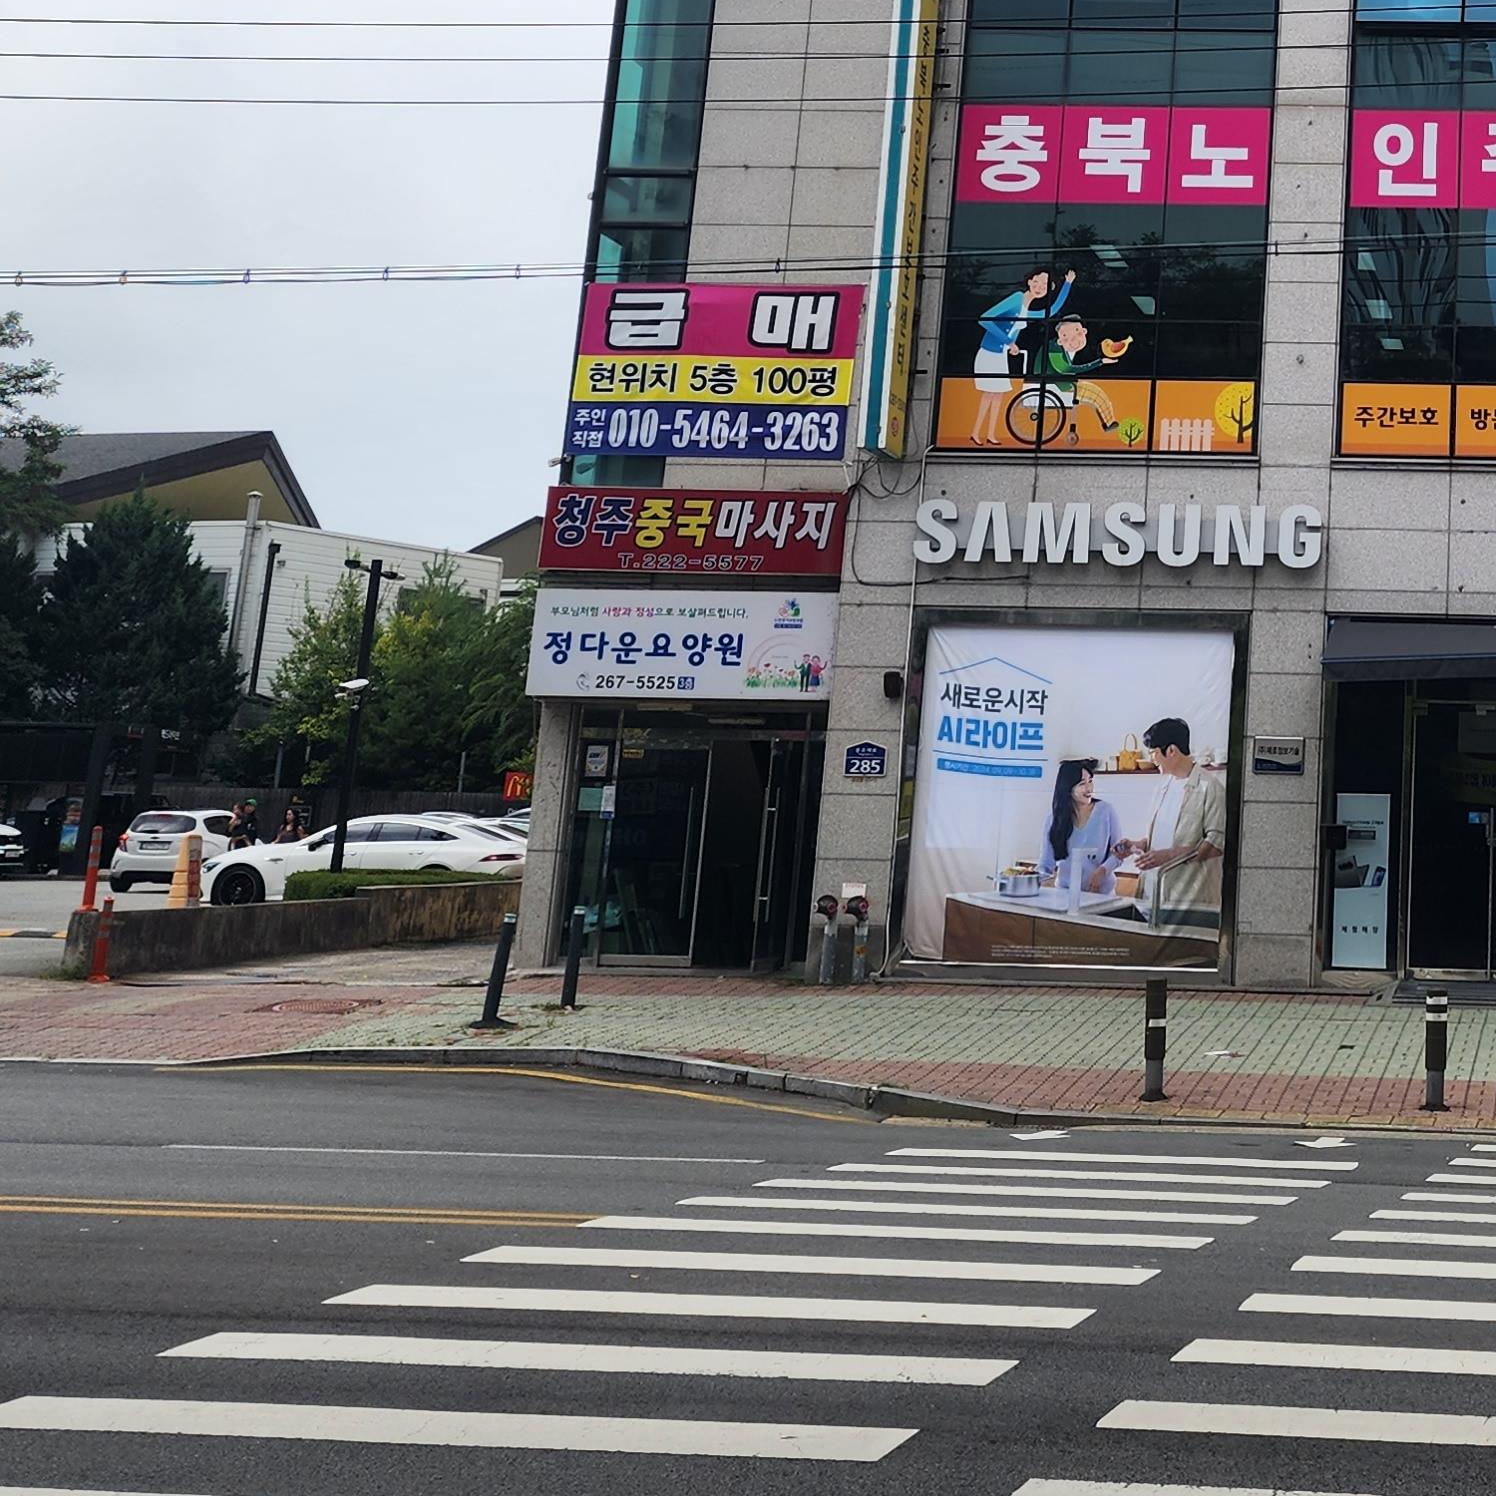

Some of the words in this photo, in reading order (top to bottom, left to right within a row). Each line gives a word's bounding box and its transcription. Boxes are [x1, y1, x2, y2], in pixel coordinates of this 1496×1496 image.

[975, 115, 1254, 193] 충북노
[589, 362, 678, 393] 현위치
[689, 364, 738, 395] 5층
[753, 366, 838, 397] 100평
[574, 409, 606, 426] 주인
[607, 408, 840, 452] 010-5464-3263
[1354, 406, 1440, 429] 주간보호
[572, 430, 604, 449] 직접
[554, 493, 838, 550] 청주중국마사지
[912, 499, 1322, 569] SAMSUNG
[617, 553, 765, 571] T.222-5577
[543, 631, 745, 667] 정다운요양원
[595, 674, 676, 690] 267-5525
[940, 681, 1049, 716] 새로운시작
[936, 715, 1045, 751] AI라이프
[849, 759, 881, 774] 285
